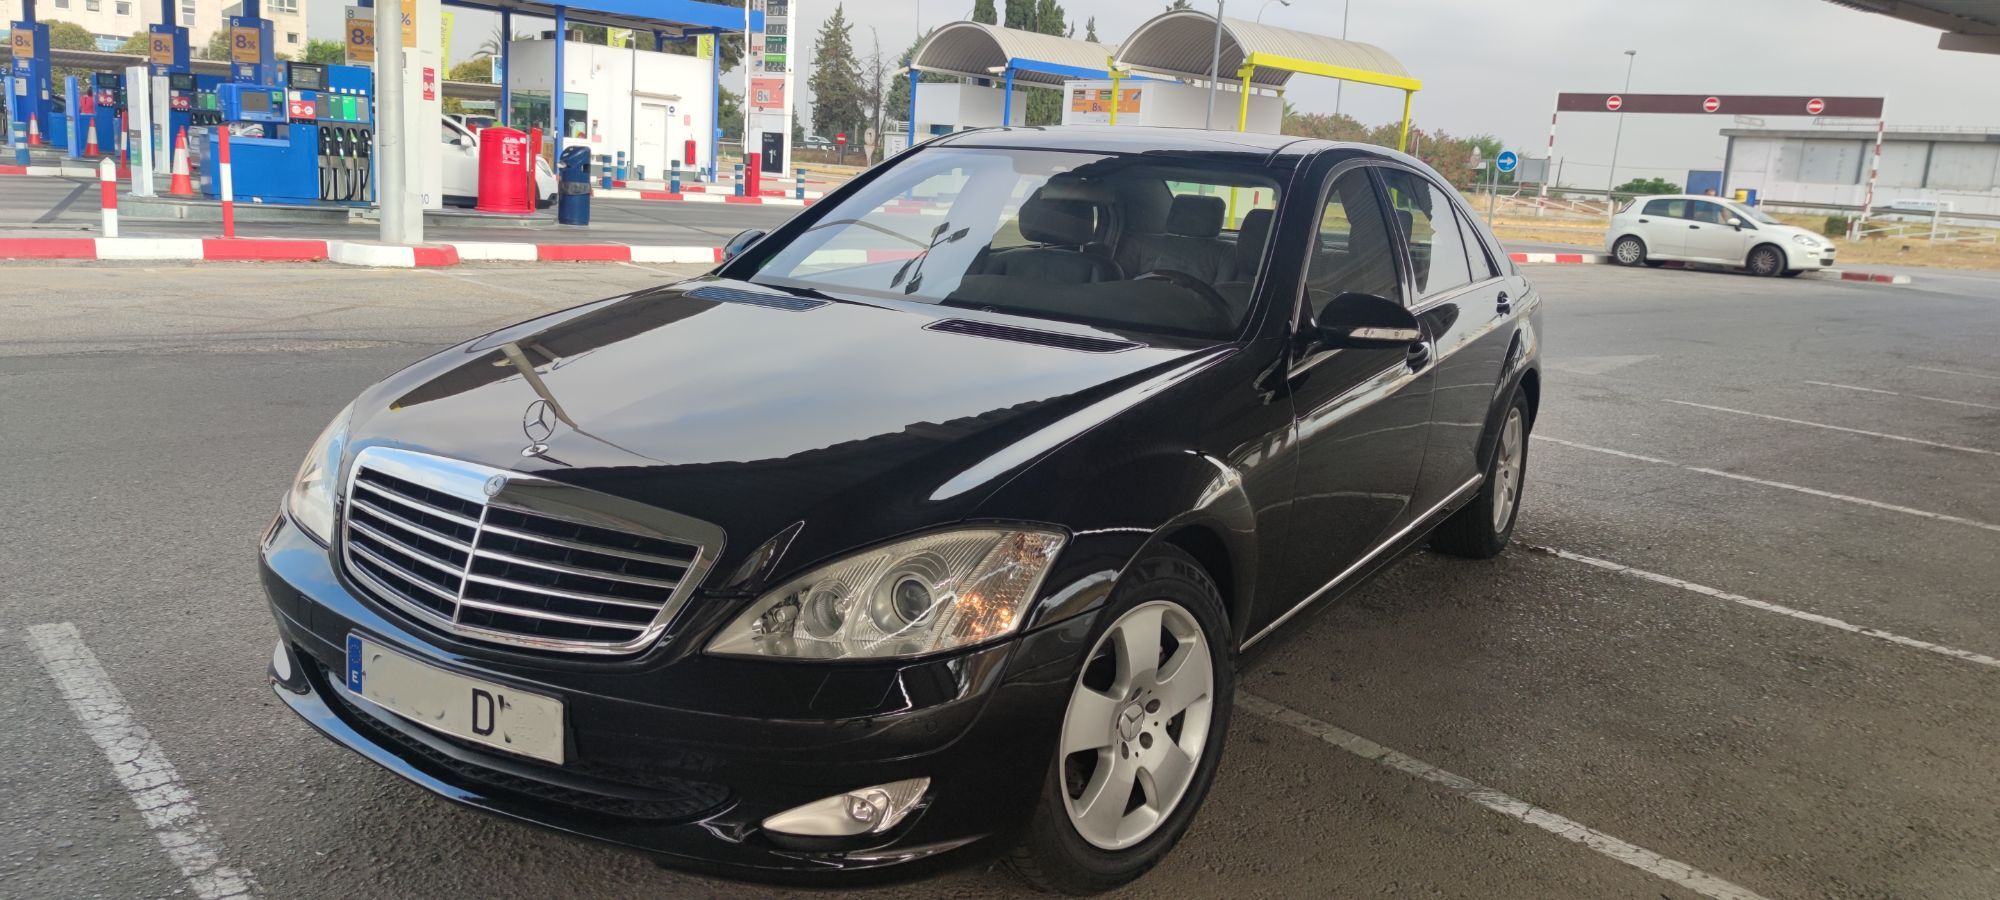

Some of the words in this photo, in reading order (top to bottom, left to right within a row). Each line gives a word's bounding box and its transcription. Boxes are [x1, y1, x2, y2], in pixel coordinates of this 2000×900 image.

[347, 9, 354, 18] 8
[233, 18, 239, 27] 6
[15, 35, 31, 47] 8%
[154, 40, 170, 53] 8%
[236, 35, 256, 50] 8%
[757, 90, 769, 102] 8%
[351, 669, 359, 684] E
